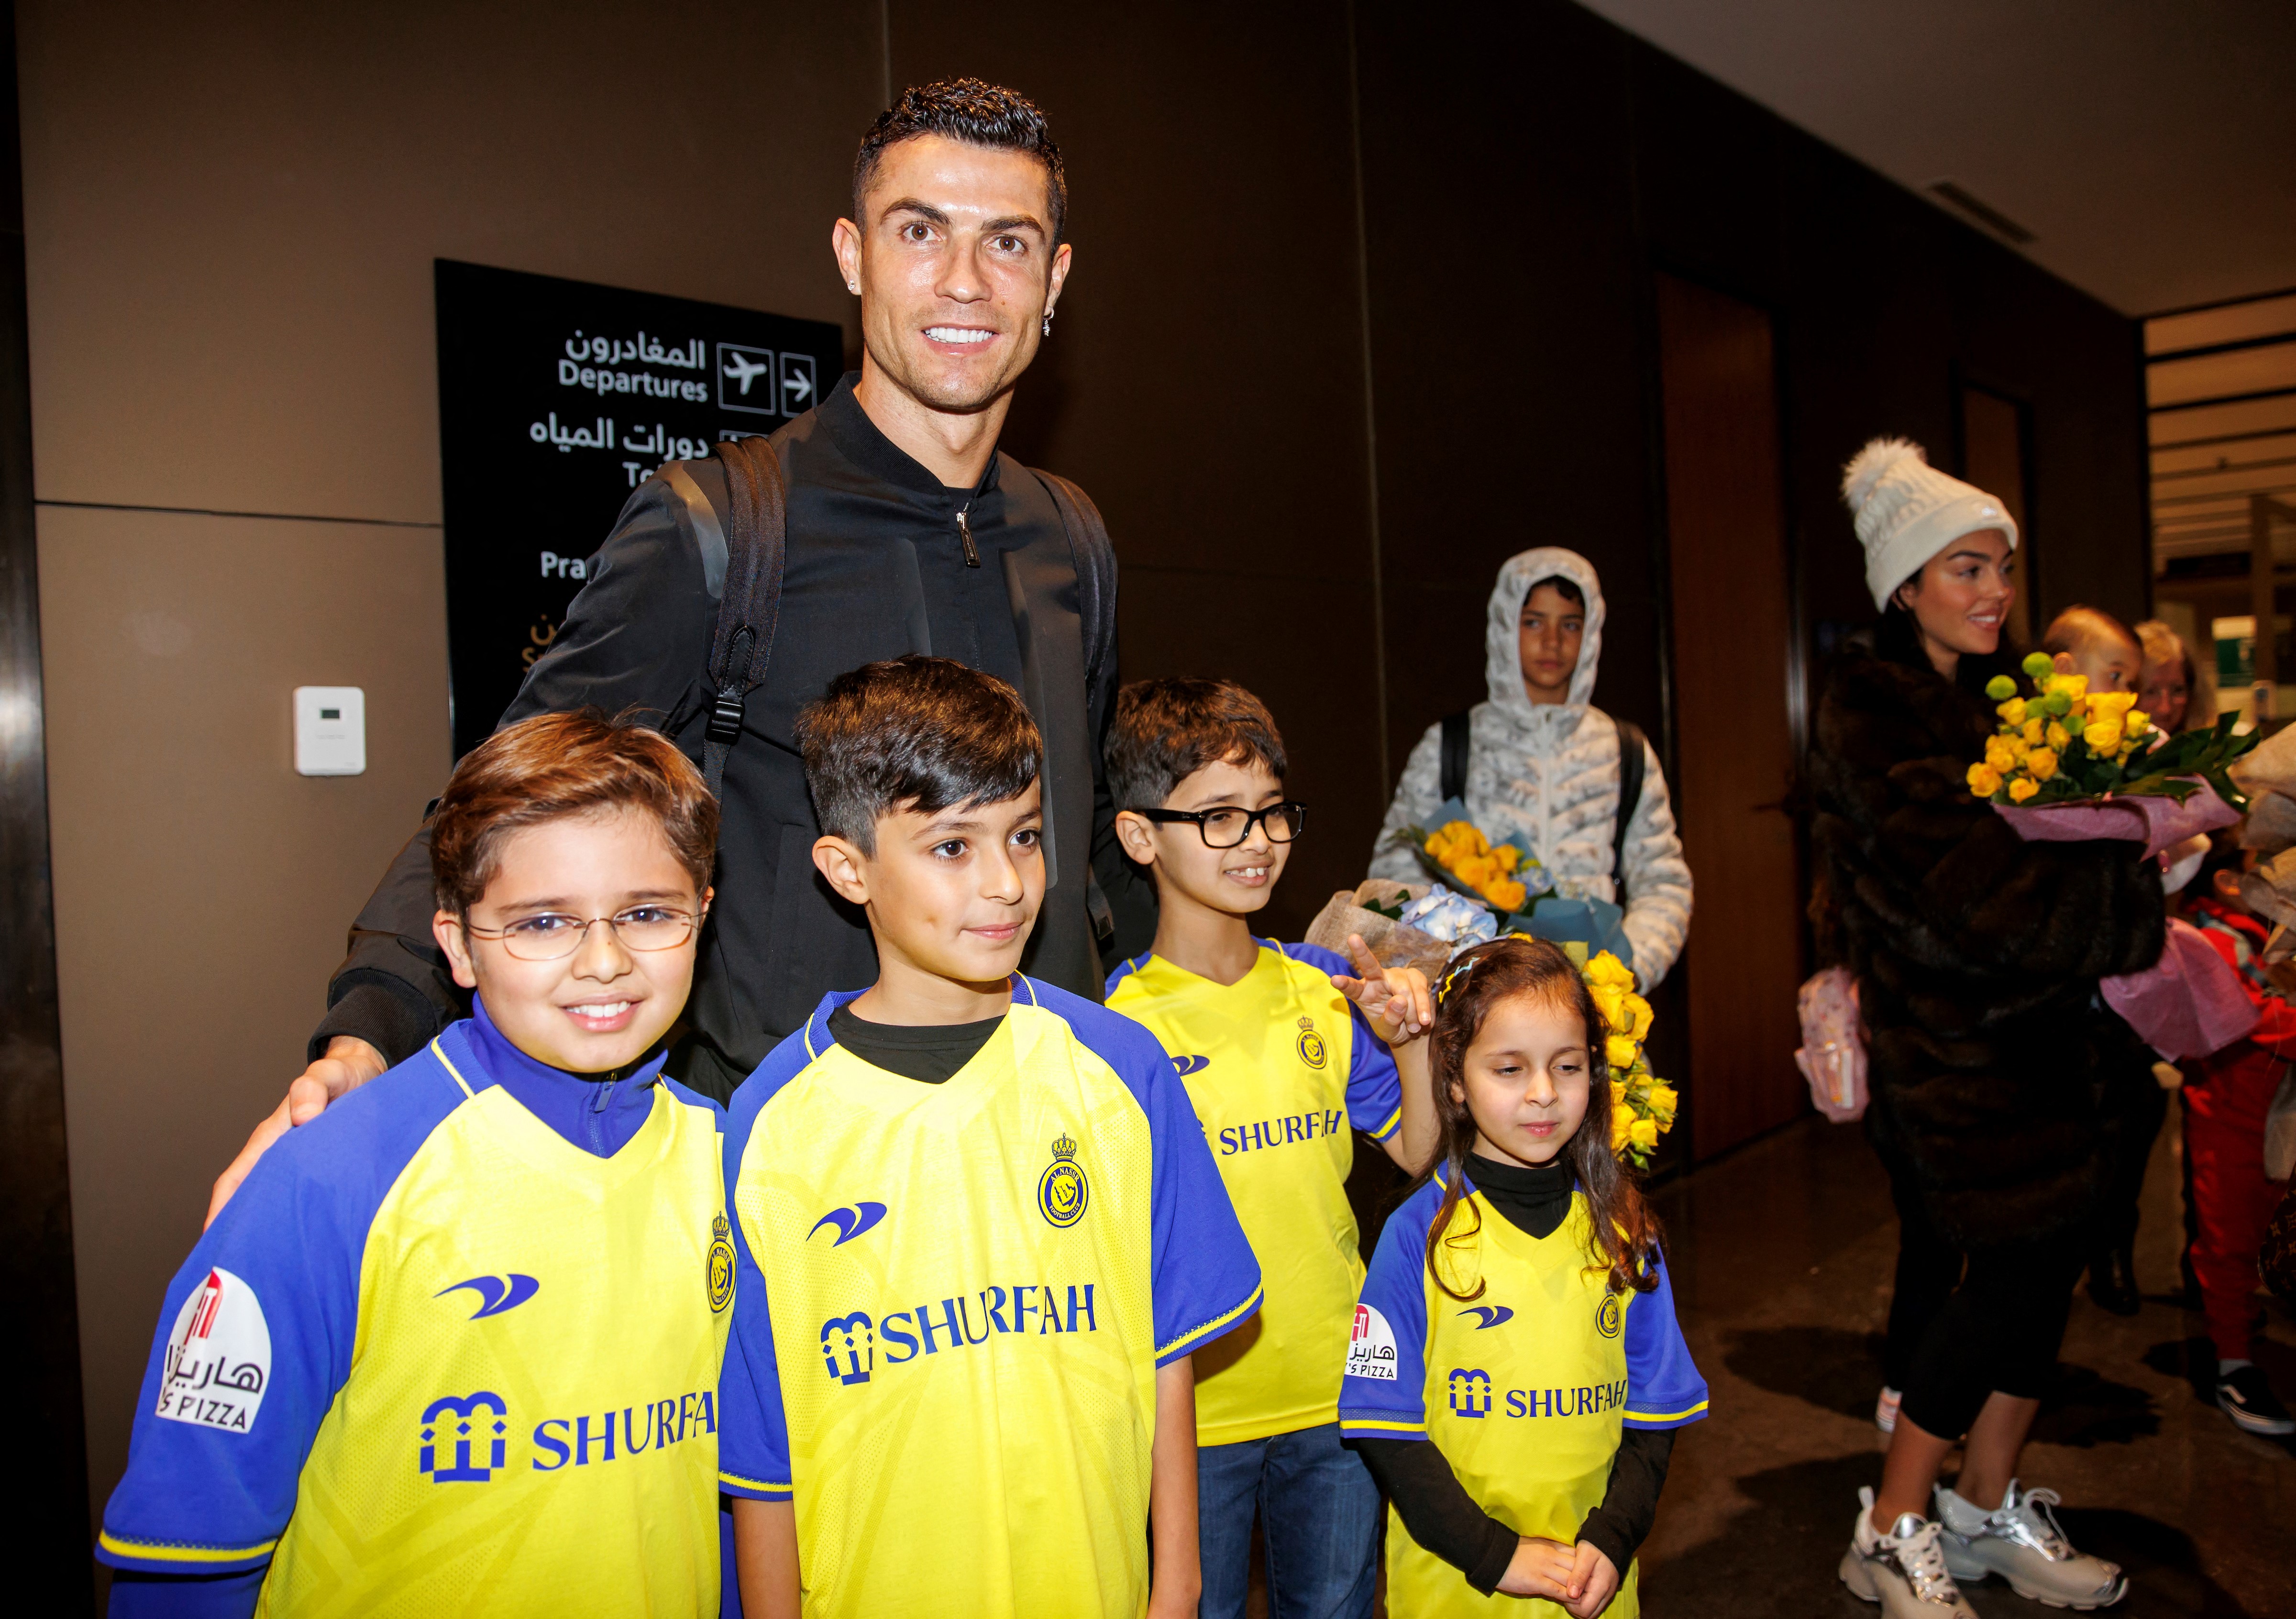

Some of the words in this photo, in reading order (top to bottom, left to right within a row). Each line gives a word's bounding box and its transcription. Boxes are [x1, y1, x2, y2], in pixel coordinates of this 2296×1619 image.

[565, 329, 706, 370] المغادرون
[558, 359, 708, 402] Departures
[530, 411, 615, 453] المياه
[623, 423, 709, 462] دورات
[541, 551, 590, 584] Pra
[1219, 1110, 1343, 1155] SHURFH
[1050, 1171, 1060, 1182] AL
[1059, 1167, 1080, 1182] NASSR
[1049, 1205, 1071, 1219] FOOTBALL
[1070, 1202, 1081, 1216] CLUB
[880, 1284, 1096, 1363] SHURFAH
[1360, 1365, 1394, 1378] PIZZA
[177, 1395, 245, 1430] PIZZA
[1506, 1379, 1627, 1418] SHURFAH
[532, 1391, 717, 1471] SHURFA
